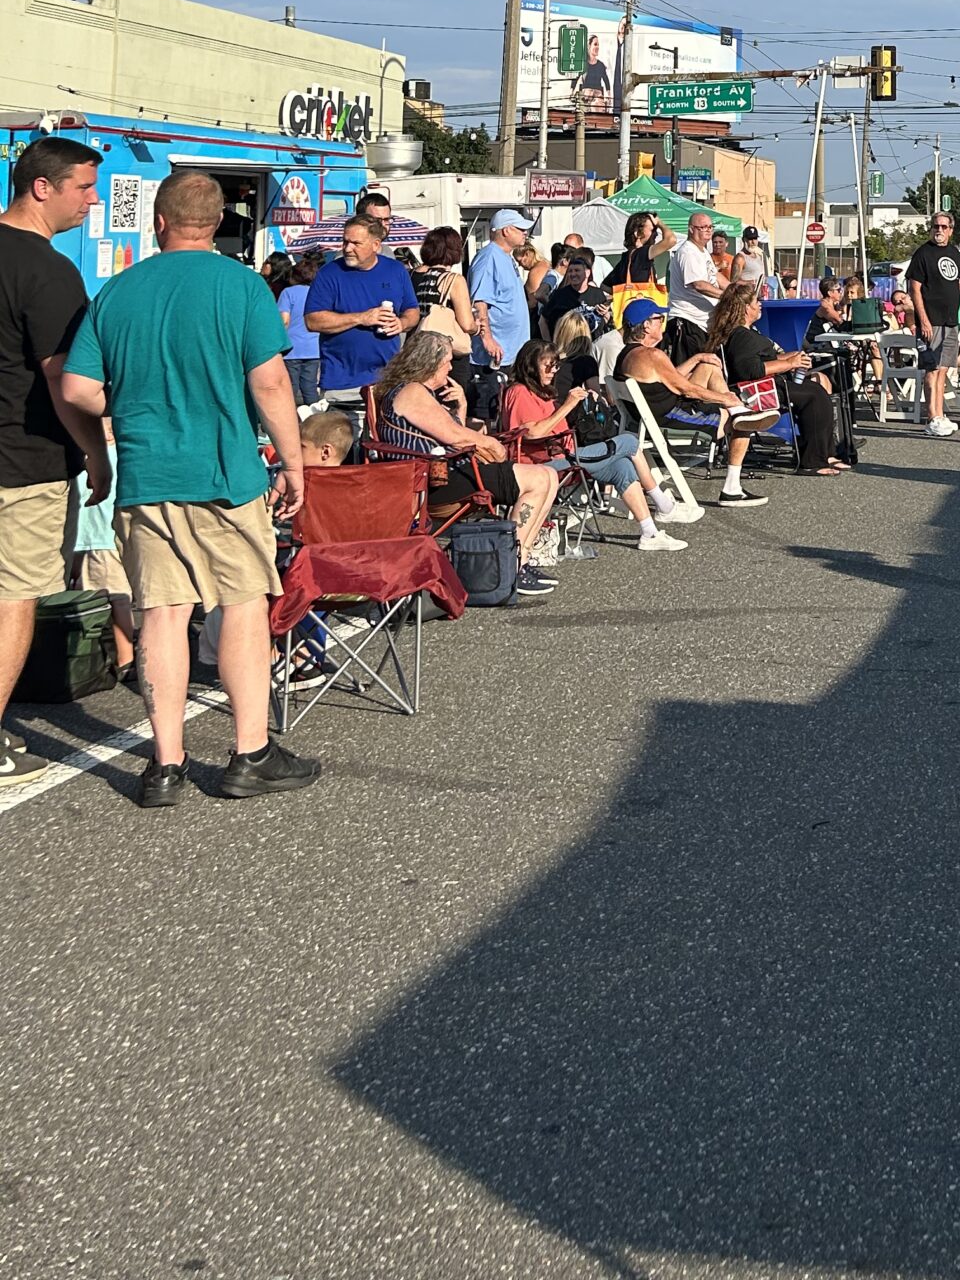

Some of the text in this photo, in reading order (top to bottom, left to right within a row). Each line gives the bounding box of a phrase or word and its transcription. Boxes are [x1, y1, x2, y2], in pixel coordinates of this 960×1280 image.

[520, 51, 558, 64] Jeffeon
[520, 65, 542, 77] Heal
[656, 85, 745, 98] Frankford Av
[697, 99, 706, 108] 13
[279, 83, 373, 141] cricket
[611, 195, 660, 205] thrive
[287, 209, 315, 223] FACTORY
[941, 260, 956, 277] SIG
